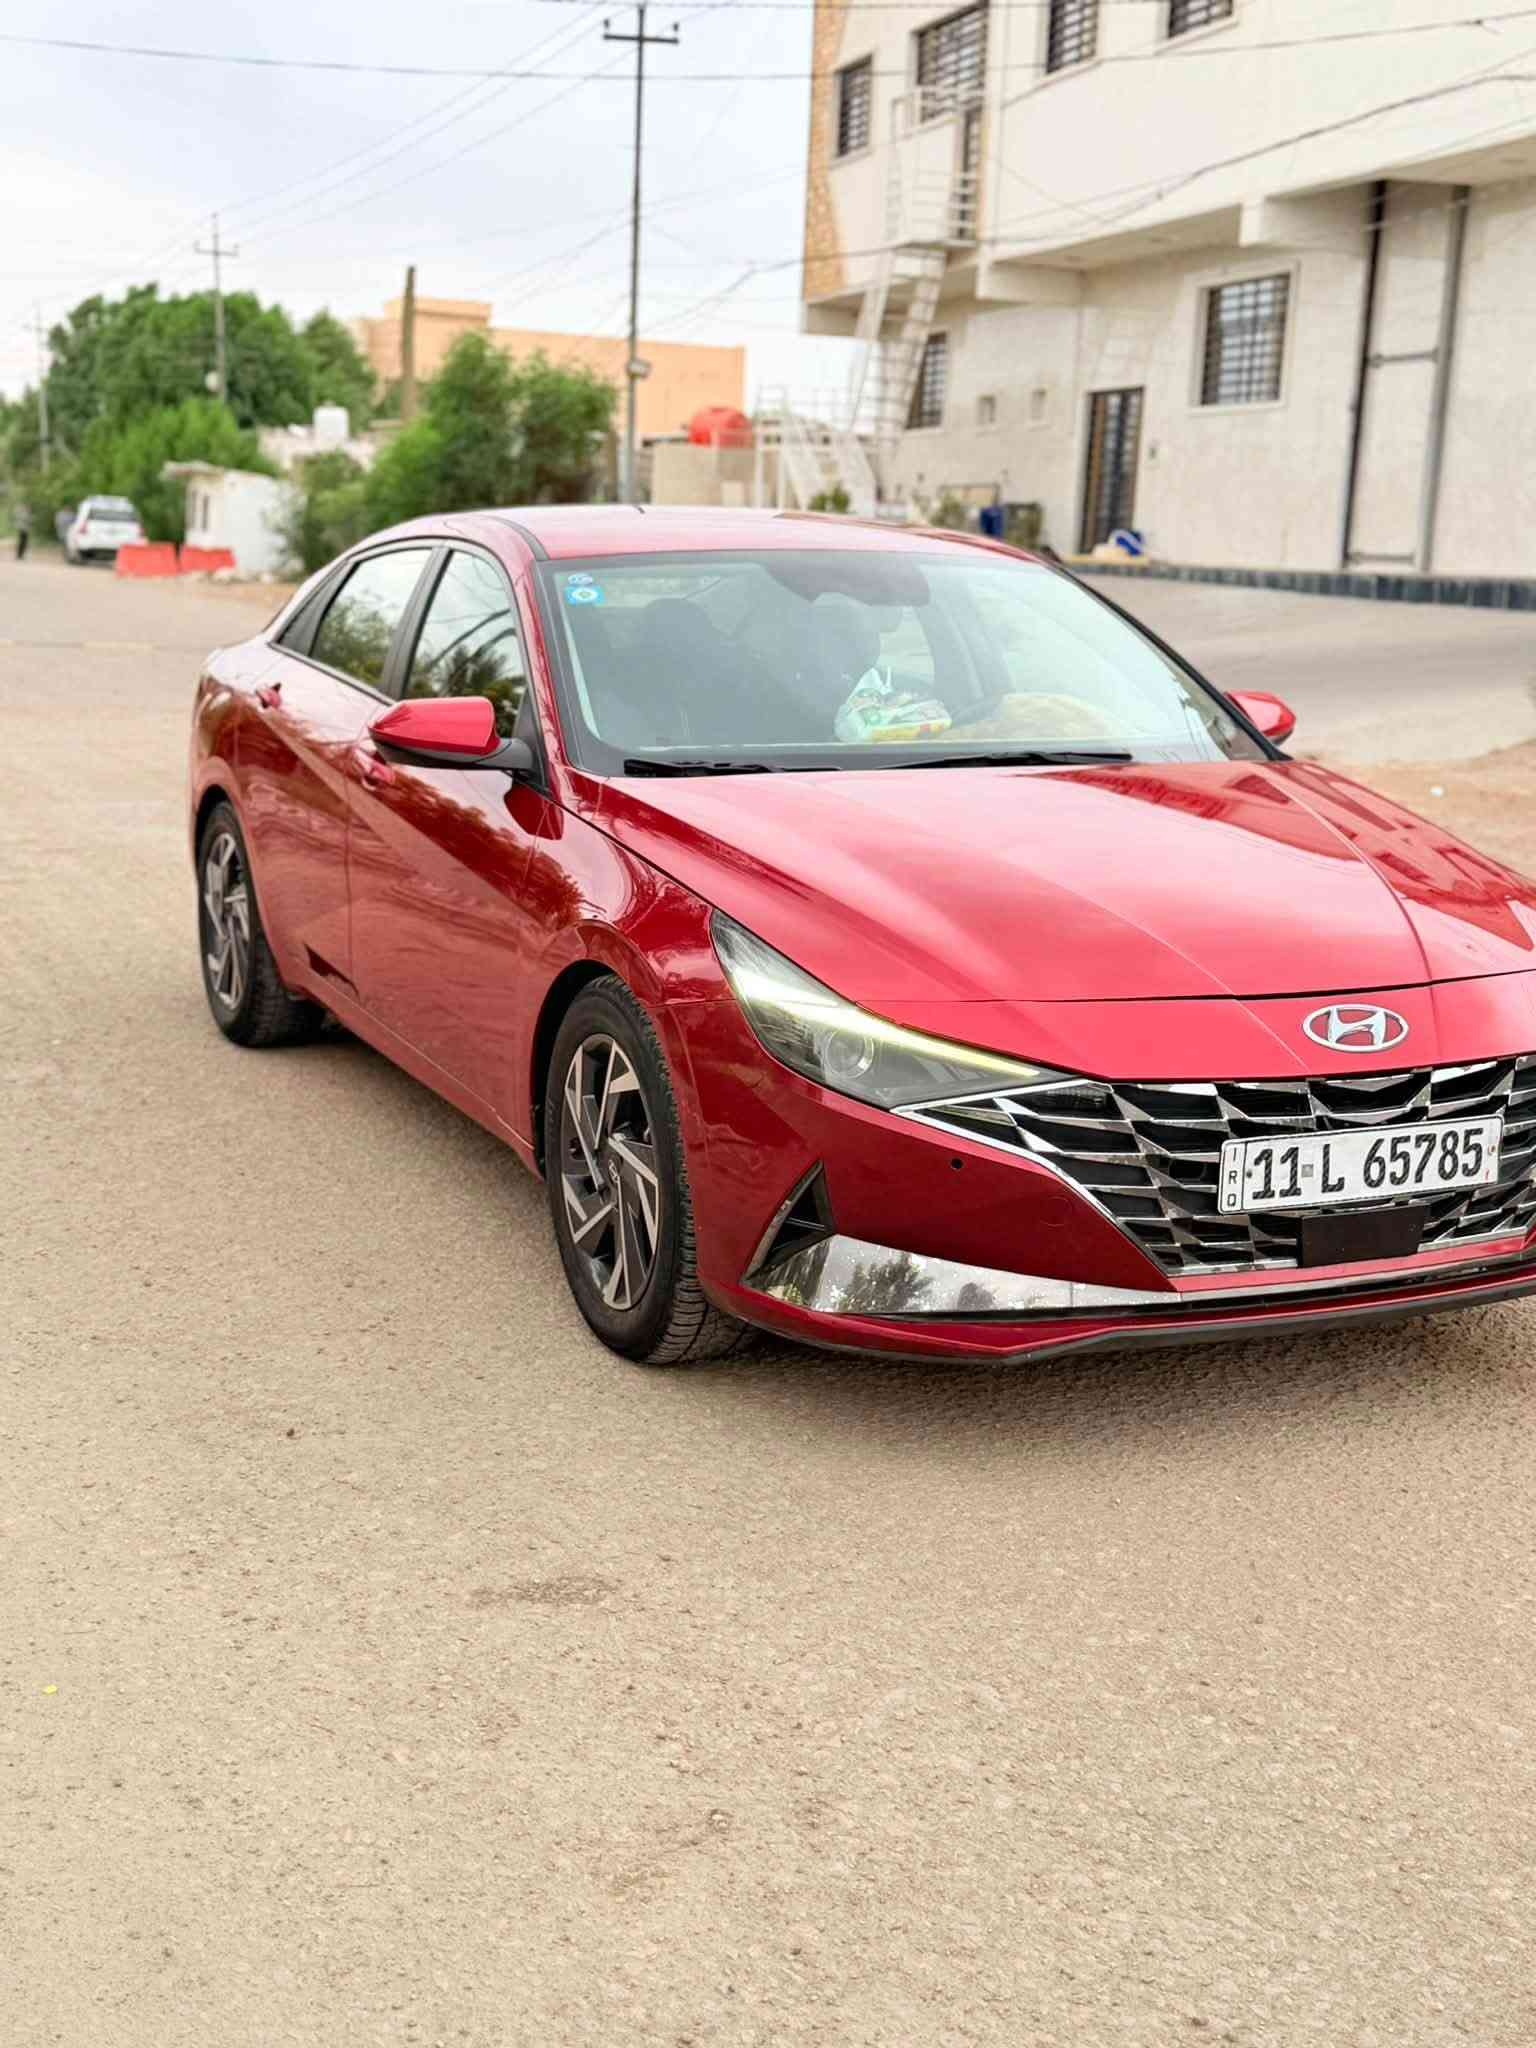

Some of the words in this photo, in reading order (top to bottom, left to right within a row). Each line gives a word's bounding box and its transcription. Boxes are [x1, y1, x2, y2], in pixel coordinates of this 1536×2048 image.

[1251, 1147, 1302, 1200] 11
[1321, 1143, 1345, 1194] L
[1363, 1127, 1484, 1189] 65785
